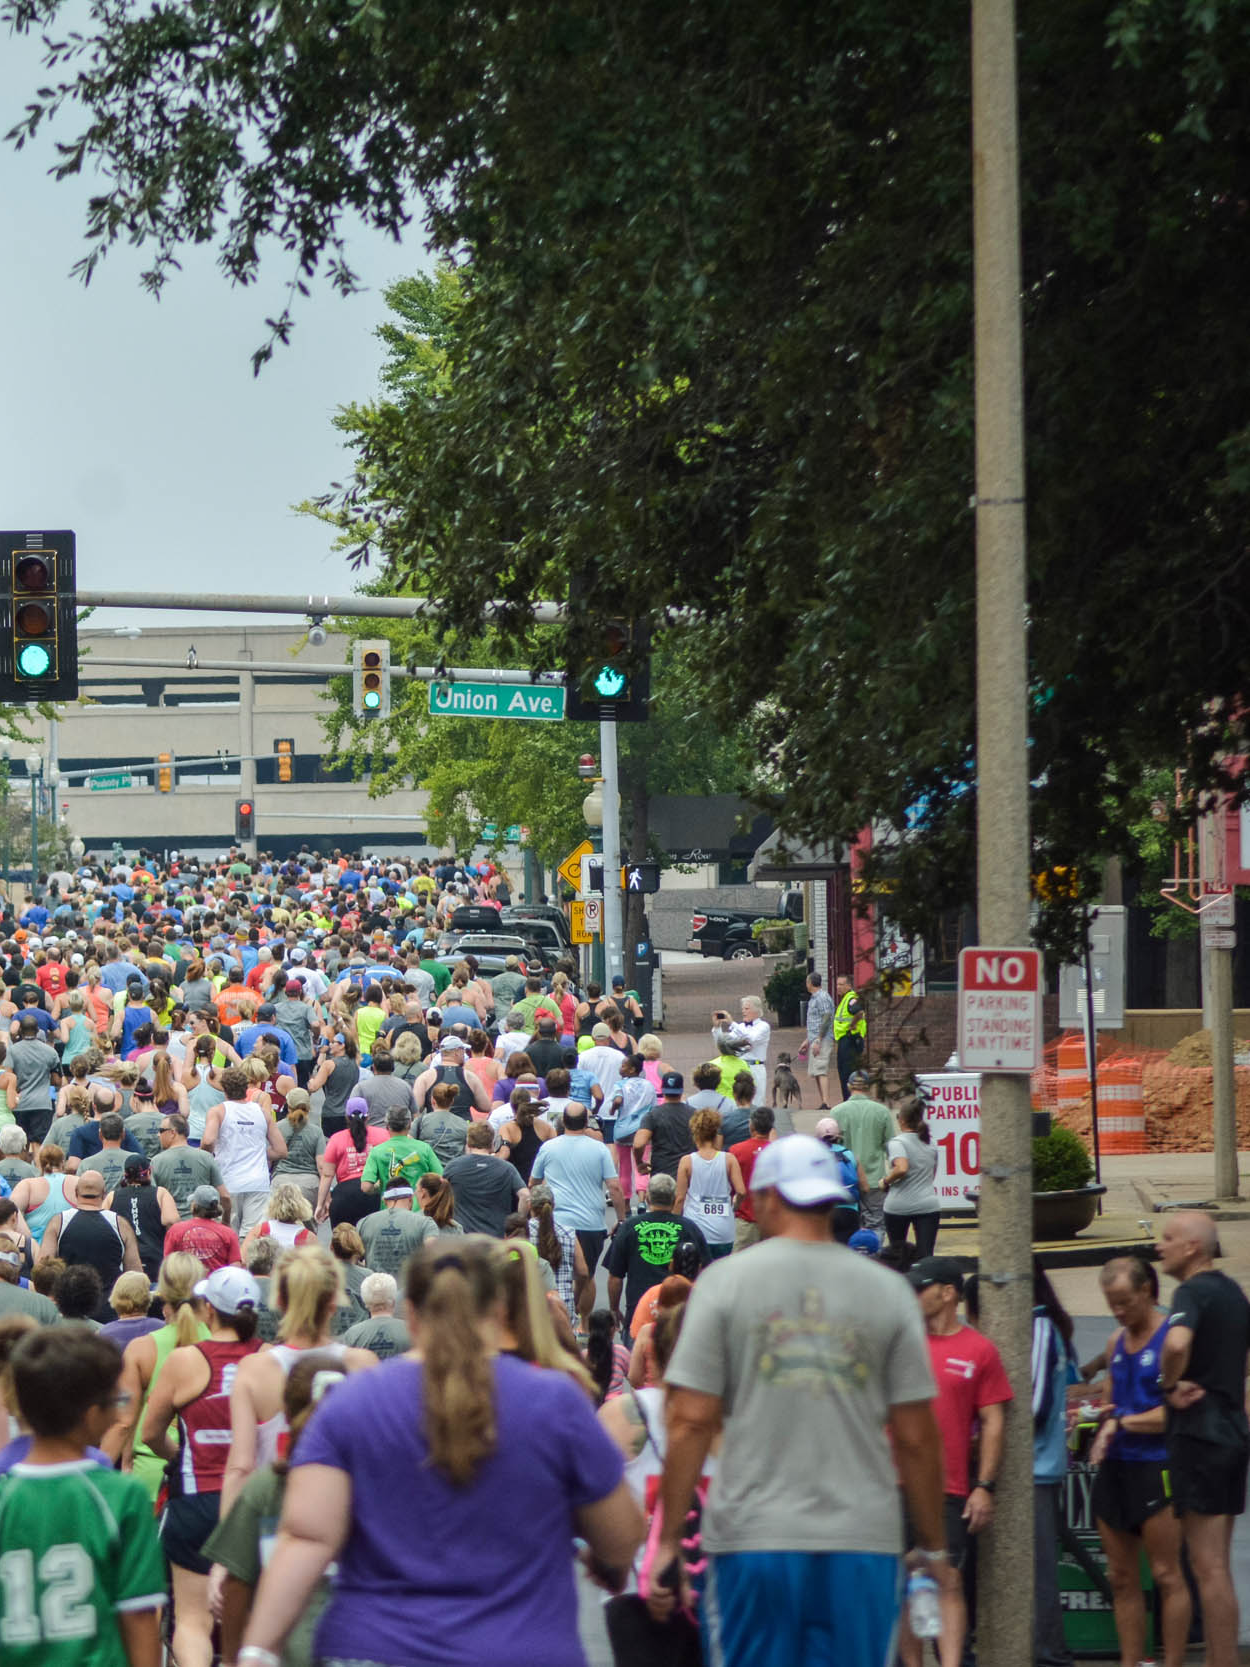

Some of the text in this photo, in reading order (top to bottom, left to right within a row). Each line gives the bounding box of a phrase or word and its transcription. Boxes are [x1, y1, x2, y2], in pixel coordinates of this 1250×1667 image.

[435, 687, 558, 713] Union Ave.
[976, 957, 1025, 984] NO
[966, 996, 1030, 1011] PARKING
[966, 1018, 1031, 1032] STANDING
[966, 1036, 1031, 1051] ANYTIME
[932, 1086, 981, 1101] PUBLI
[927, 1104, 982, 1120] PARKIN
[942, 1186, 959, 1196] INS
[704, 1203, 724, 1214] 689
